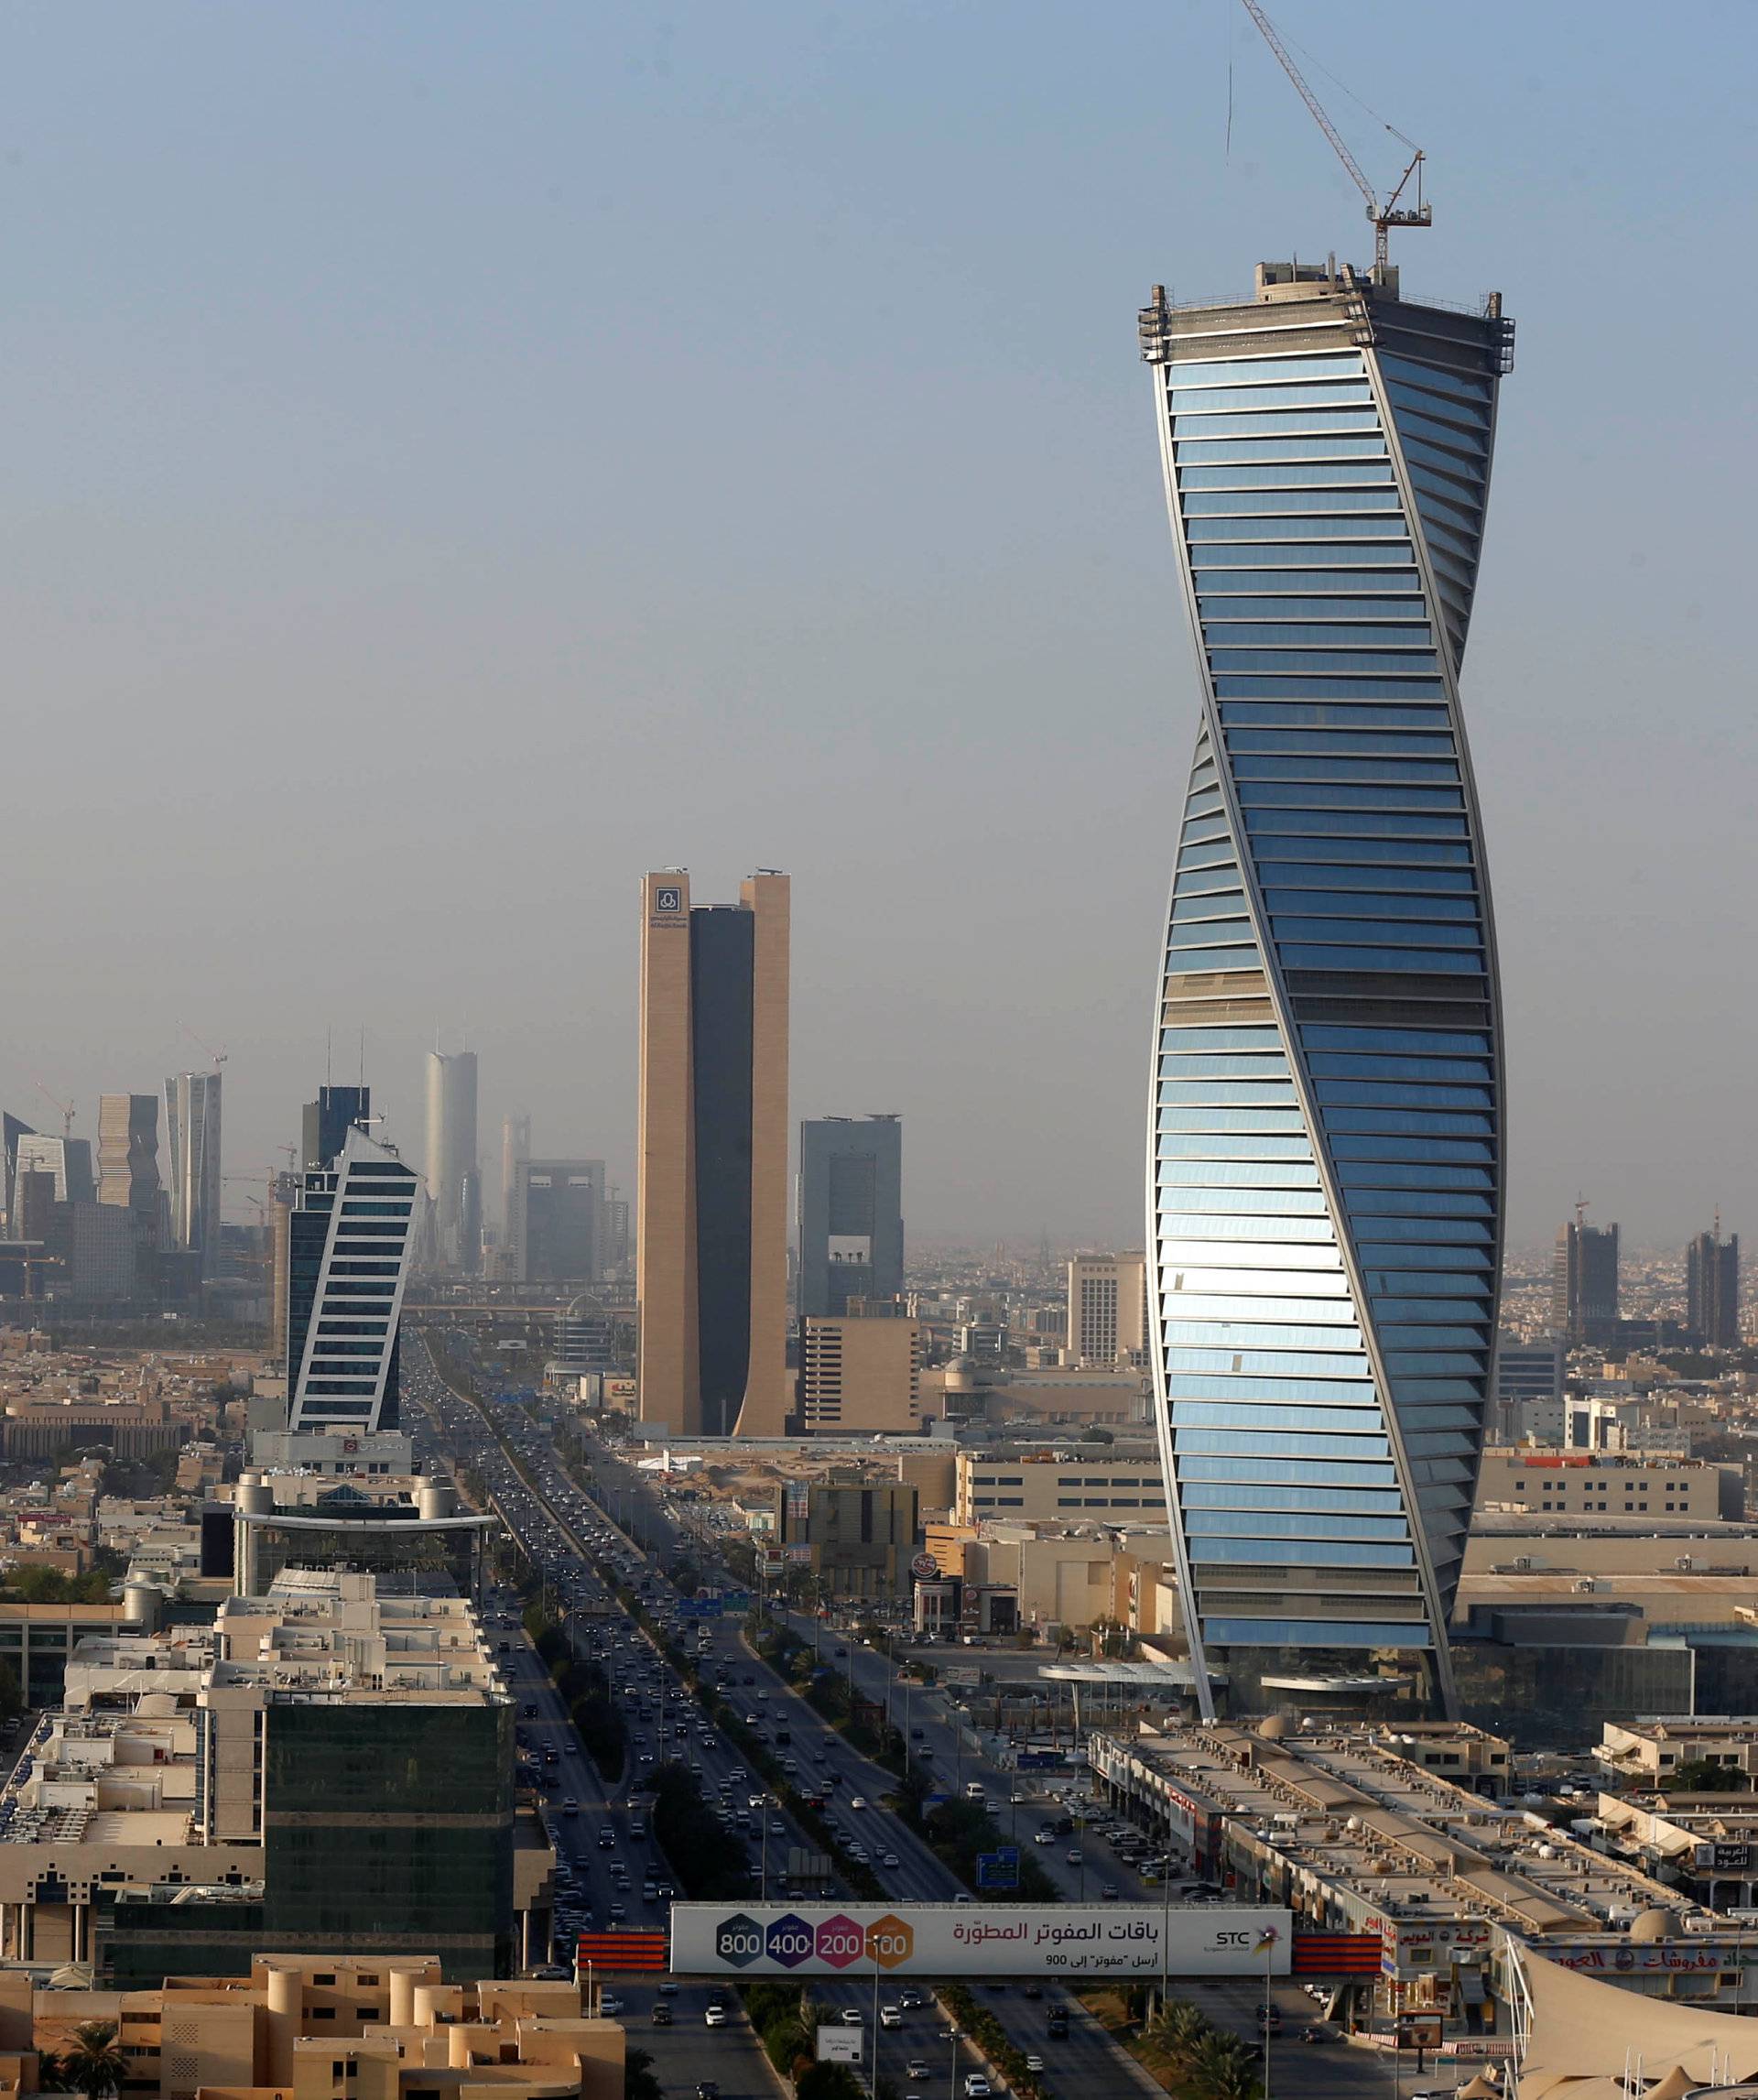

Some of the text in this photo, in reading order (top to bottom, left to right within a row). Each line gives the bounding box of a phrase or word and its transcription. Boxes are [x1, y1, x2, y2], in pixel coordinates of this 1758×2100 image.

[1717, 1856, 1747, 1868] للعود
[1034, 1922, 1101, 1945] المفوتر
[1108, 1921, 1158, 1943] باقات
[1216, 1931, 1250, 1944] STC
[1455, 1928, 1490, 1944] شركة
[720, 1934, 760, 1953] 800
[820, 1935, 859, 1954] 200
[873, 1935, 906, 1954] 00
[1046, 1954, 1067, 1965] 900
[1132, 1953, 1158, 1967] أرسل
[1643, 1951, 1718, 1971] مفروشات
